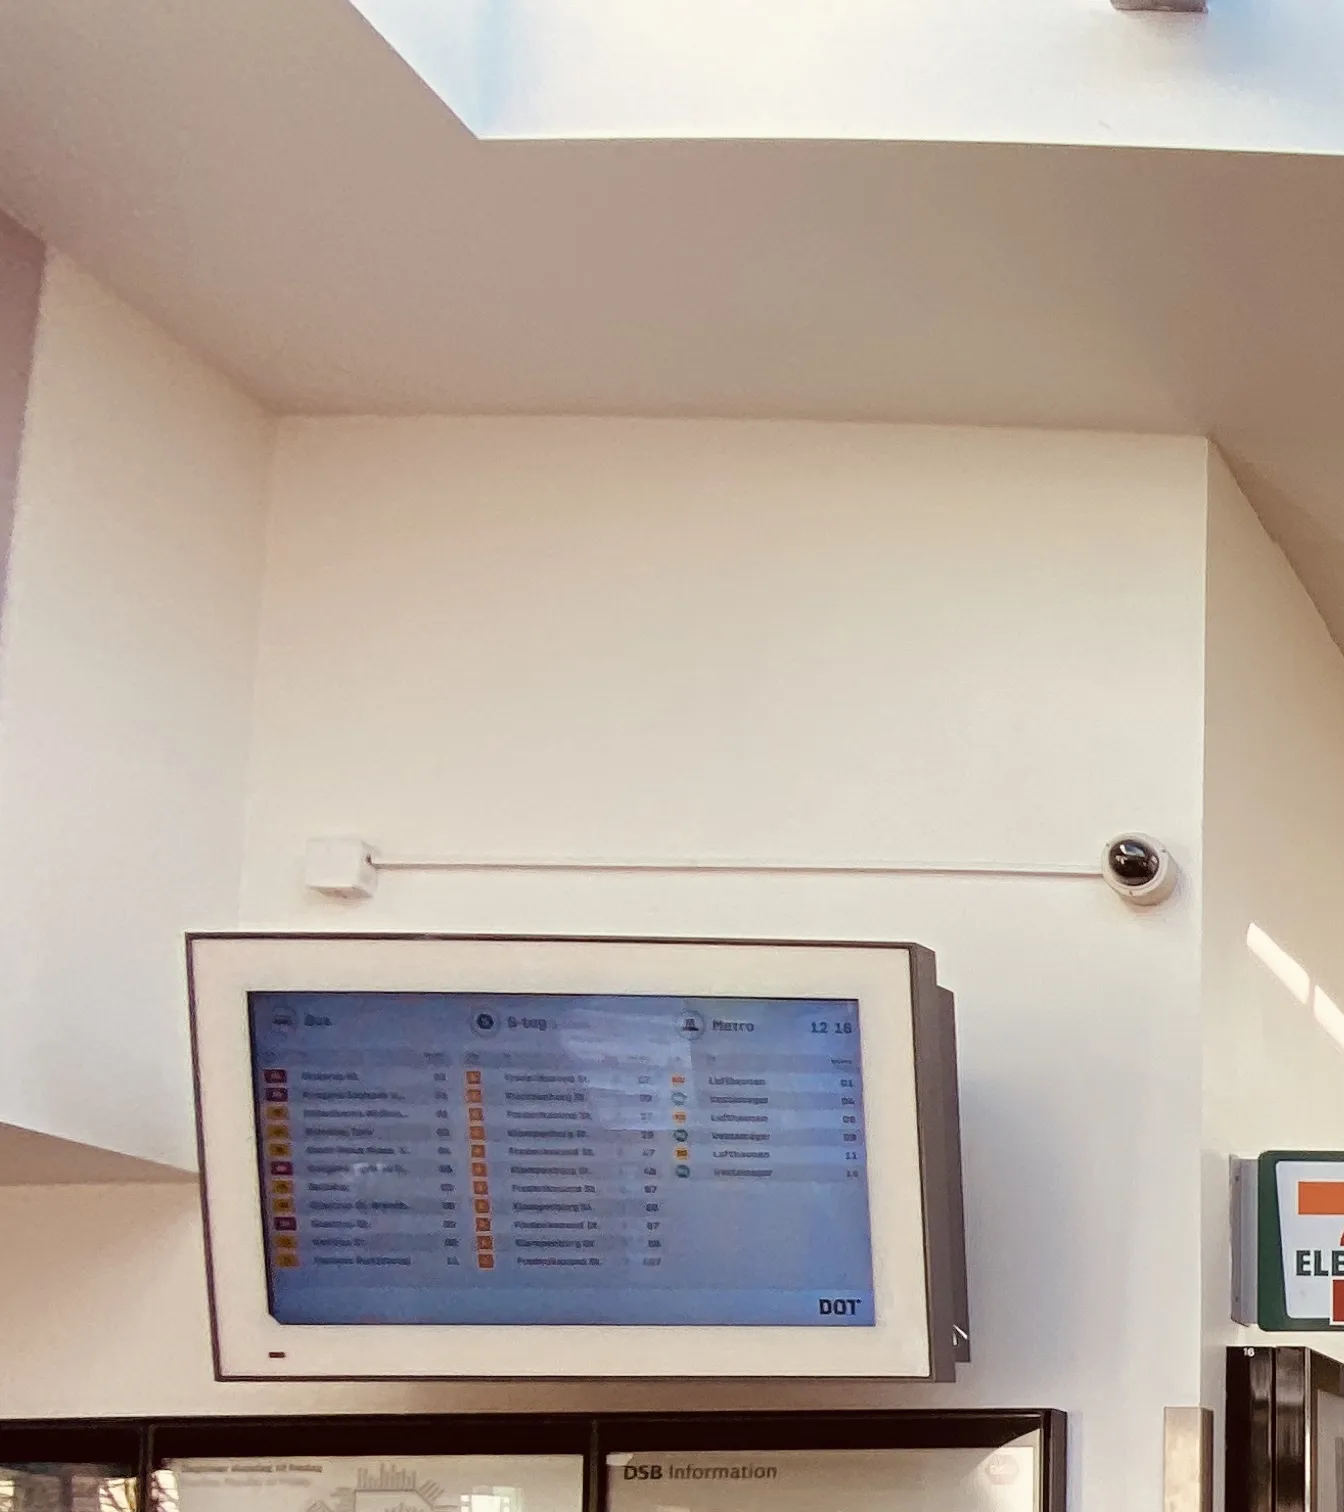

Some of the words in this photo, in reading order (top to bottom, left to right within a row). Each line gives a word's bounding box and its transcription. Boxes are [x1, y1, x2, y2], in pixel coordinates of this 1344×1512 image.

[712, 1020, 755, 1032] Metro
[819, 1298, 861, 1316] DOT
[623, 1465, 663, 1480] DSB
[669, 1463, 777, 1479] Information
